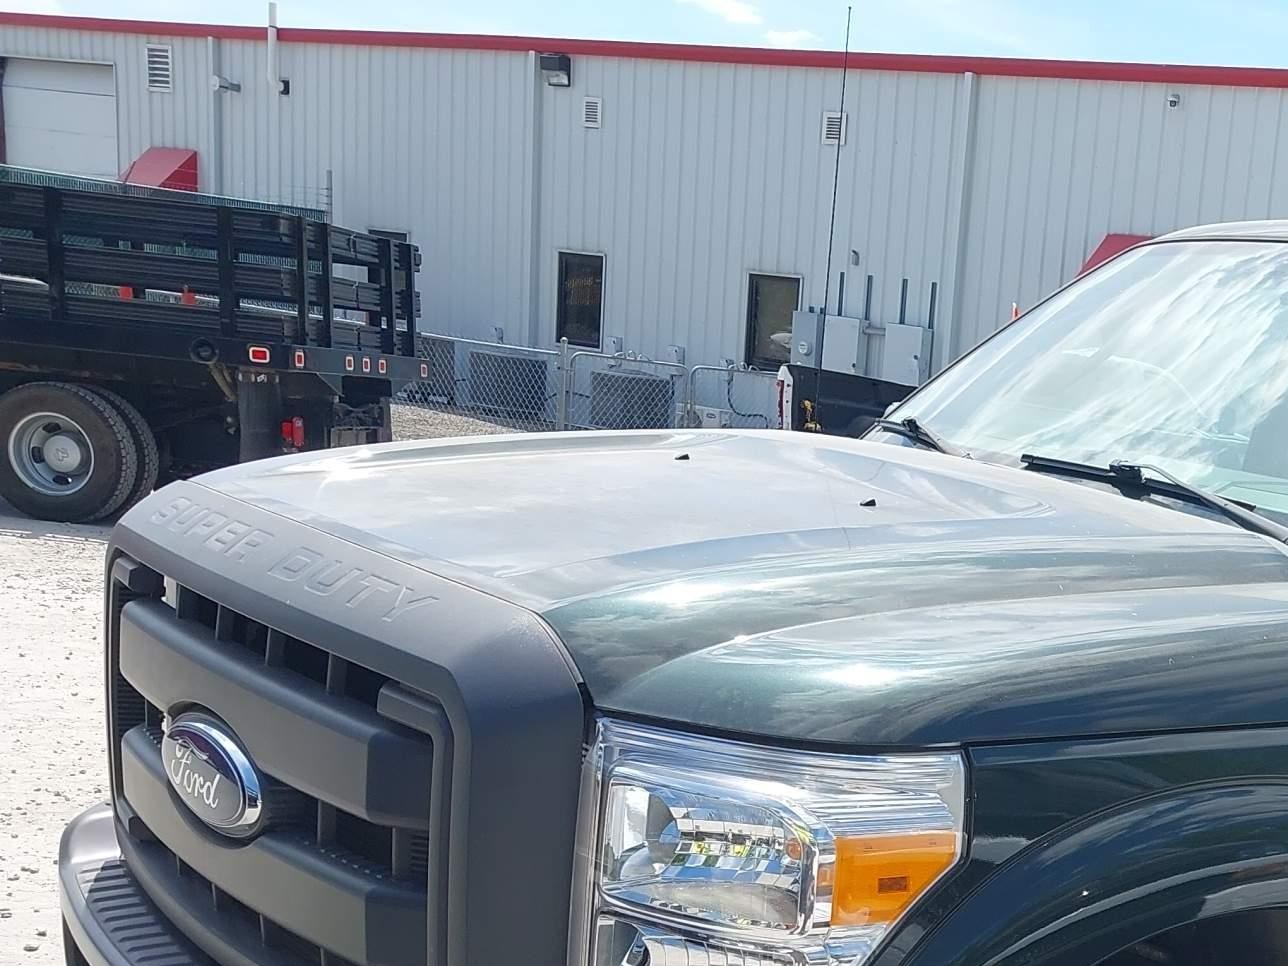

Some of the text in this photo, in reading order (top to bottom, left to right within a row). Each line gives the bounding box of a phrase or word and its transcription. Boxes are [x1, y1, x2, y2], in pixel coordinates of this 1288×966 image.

[151, 496, 440, 622] SUPER DUTY
[171, 737, 220, 808] Ford
